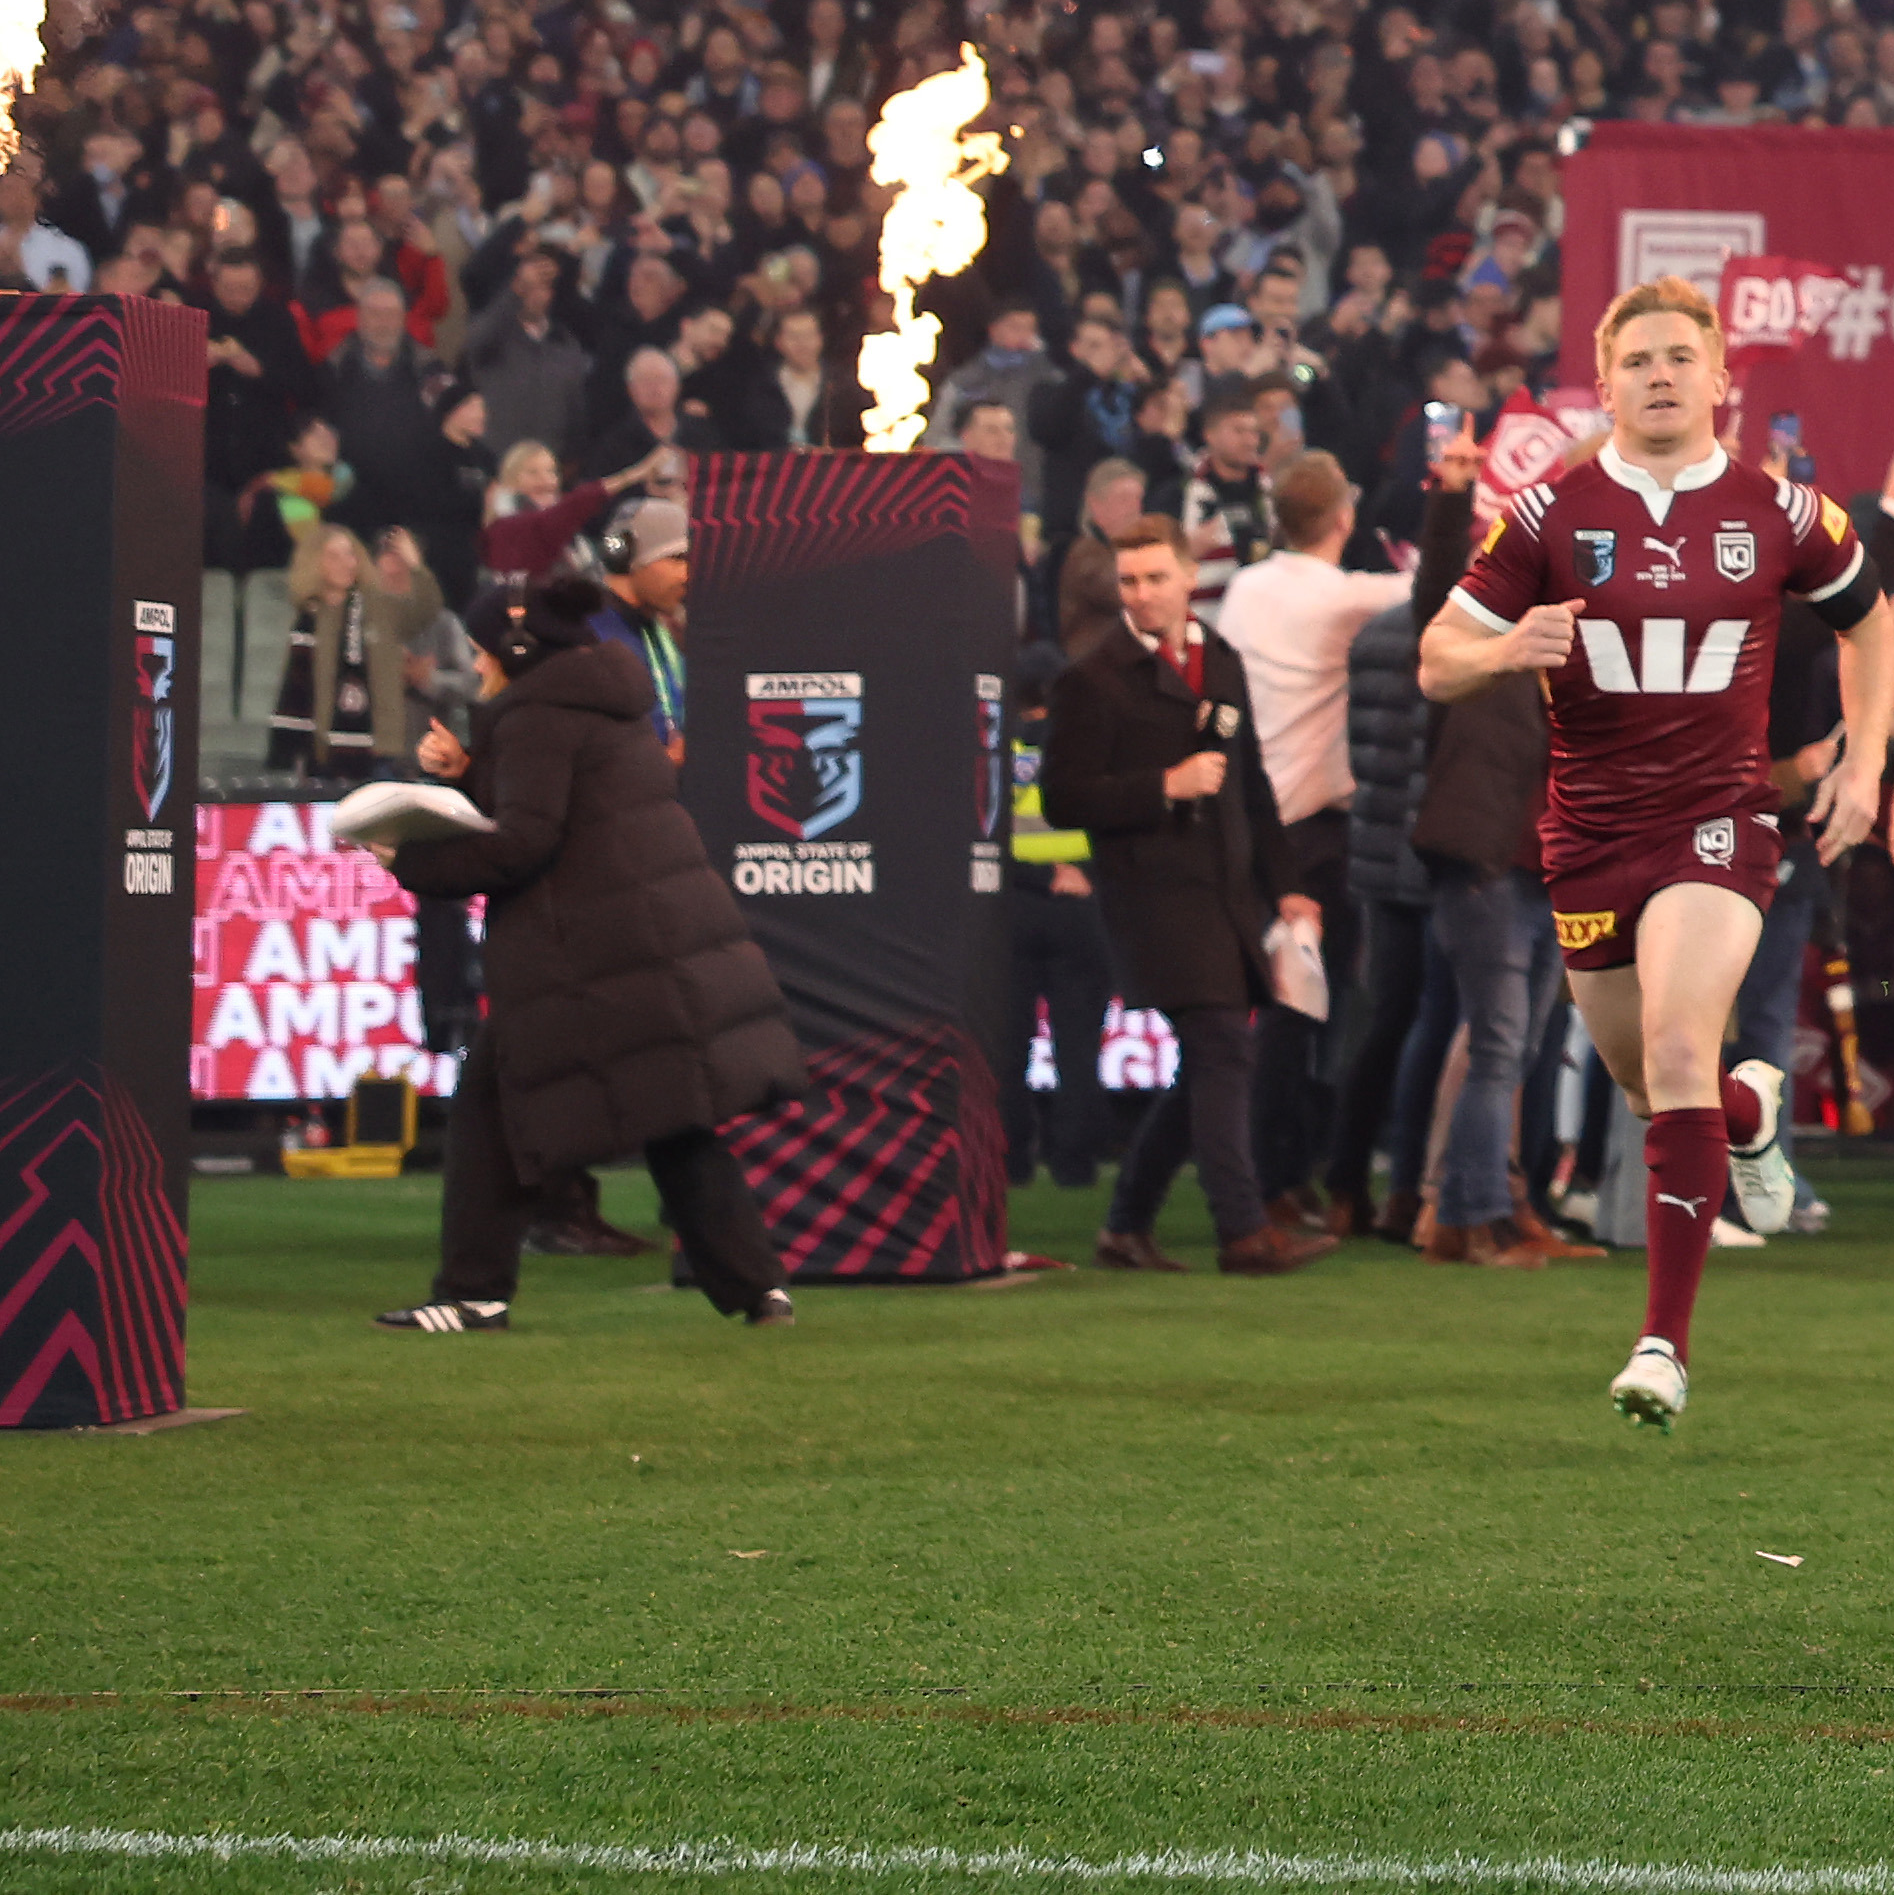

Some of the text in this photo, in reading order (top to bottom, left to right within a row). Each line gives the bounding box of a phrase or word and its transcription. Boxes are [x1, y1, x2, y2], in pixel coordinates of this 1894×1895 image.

[761, 679, 848, 693] AMPOL
[125, 852, 173, 895] ORIGIN
[732, 859, 874, 895] ORIGIN
